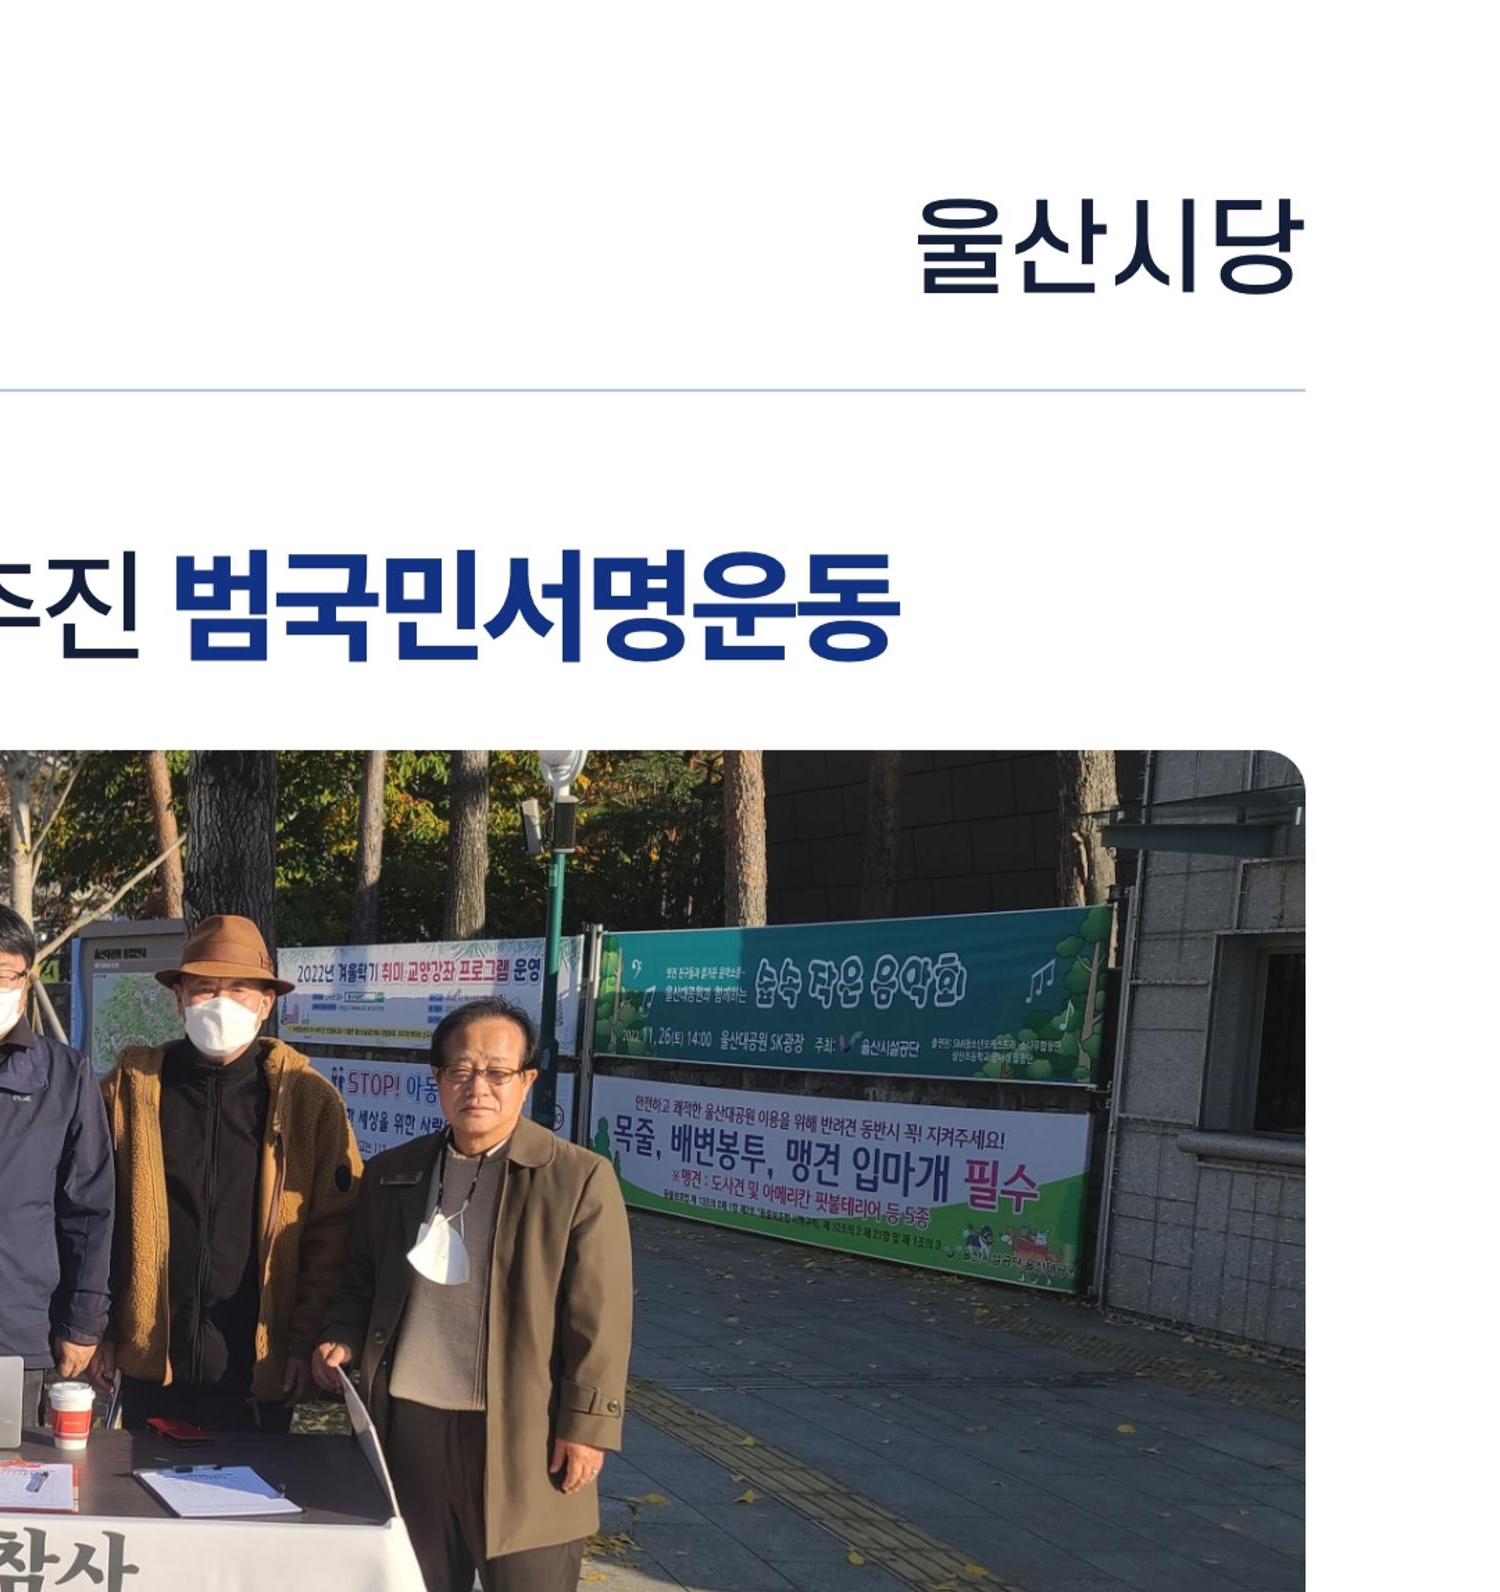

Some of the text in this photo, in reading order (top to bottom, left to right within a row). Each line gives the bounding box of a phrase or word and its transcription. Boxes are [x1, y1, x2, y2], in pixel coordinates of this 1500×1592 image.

[297, 963, 335, 983] 2022년
[337, 961, 379, 983] 겨울학기
[458, 958, 511, 982] 프로그램
[513, 957, 542, 982] 운영
[808, 955, 864, 1009] 작은
[870, 952, 968, 1009] 음악회
[719, 1030, 768, 1052] 울산대공원
[770, 1032, 805, 1054] SK광장
[860, 1038, 921, 1059] 울산시설공단
[349, 1070, 400, 1097] STOP!
[358, 1108, 389, 1134] 세상을
[393, 1114, 416, 1136] 위한
[635, 1095, 1005, 1151] 안전하고 쾌적한 울산대공원 이용을 위해 반려견 동반시 꼭! 지켜주세요!
[613, 1113, 1041, 1215] 목줄, 배변봉투, 맹견 입마개 필수
[710, 1174, 745, 1198] 도사견
[747, 1181, 760, 1201] 및
[762, 1183, 812, 1211] 아메리칸
[814, 1189, 883, 1222] 핏불테리어
[885, 1202, 901, 1226] 등
[904, 1206, 932, 1231] 5종
